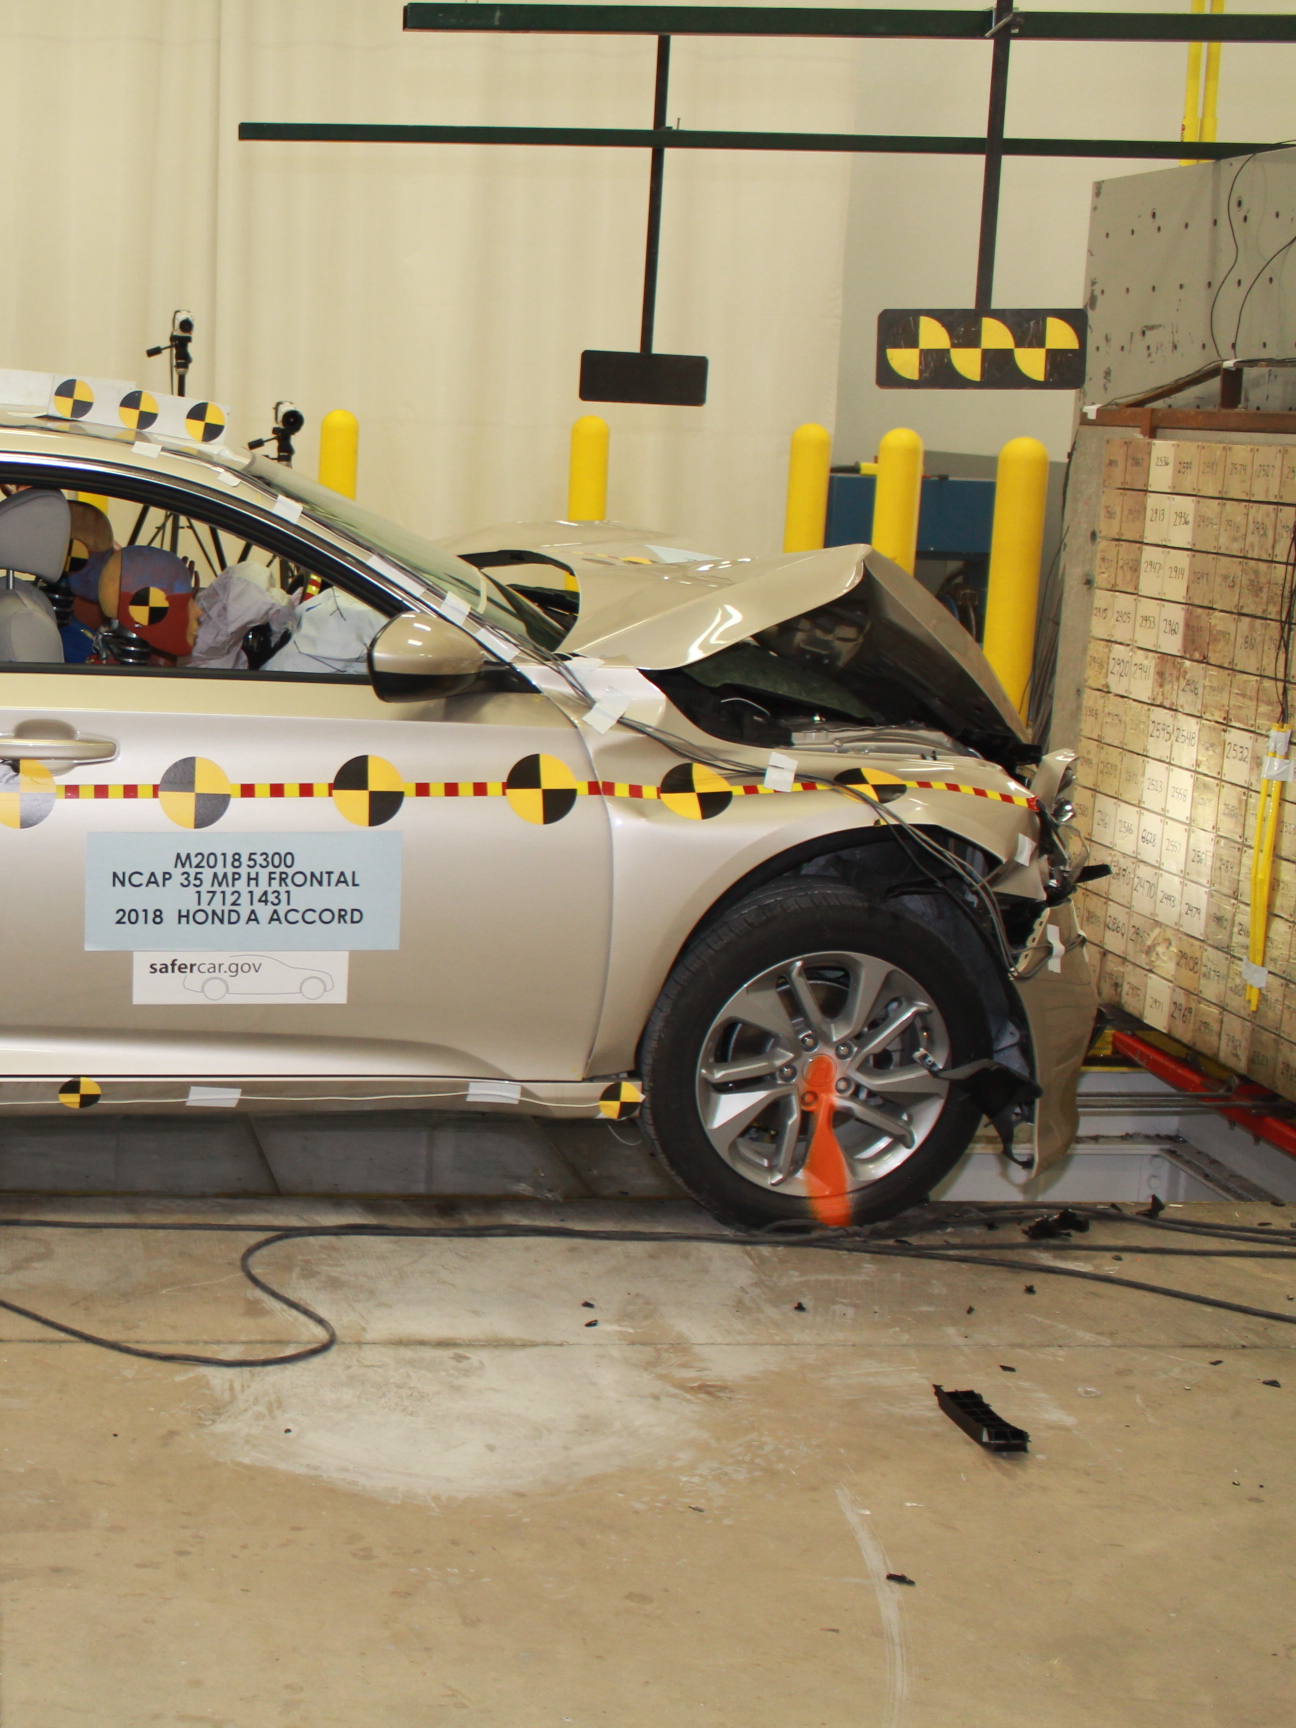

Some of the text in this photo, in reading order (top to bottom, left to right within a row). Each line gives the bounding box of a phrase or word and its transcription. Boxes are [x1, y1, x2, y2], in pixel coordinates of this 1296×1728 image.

[1155, 456, 1170, 467] 2536
[1150, 508, 1165, 522] 2913
[1173, 511, 1190, 527] 2936
[1144, 560, 1162, 574] 2947
[1169, 565, 1185, 580] 2914
[1139, 615, 1156, 630] 2953
[1163, 618, 1180, 636] 2960
[1110, 657, 1130, 678] 2920
[1132, 661, 1151, 681] 2941
[1149, 720, 1172, 743] 2595
[1175, 727, 1196, 747] 2548
[1225, 741, 1250, 764] 2532
[1147, 777, 1163, 793] 2523
[1171, 785, 1188, 802] 2558
[1119, 819, 1134, 835] 2516
[112, 870, 360, 888] NCAP 35 MPH FRONTAL
[1134, 876, 1156, 899] 2470
[1159, 890, 1176, 908] 2493
[114, 908, 364, 925] 2018 HONDA ACCORD
[1185, 902, 1201, 920] 2479
[149, 958, 263, 977] safercar.gov
[1177, 949, 1199, 975] 2908
[1170, 1001, 1193, 1025] 2969
